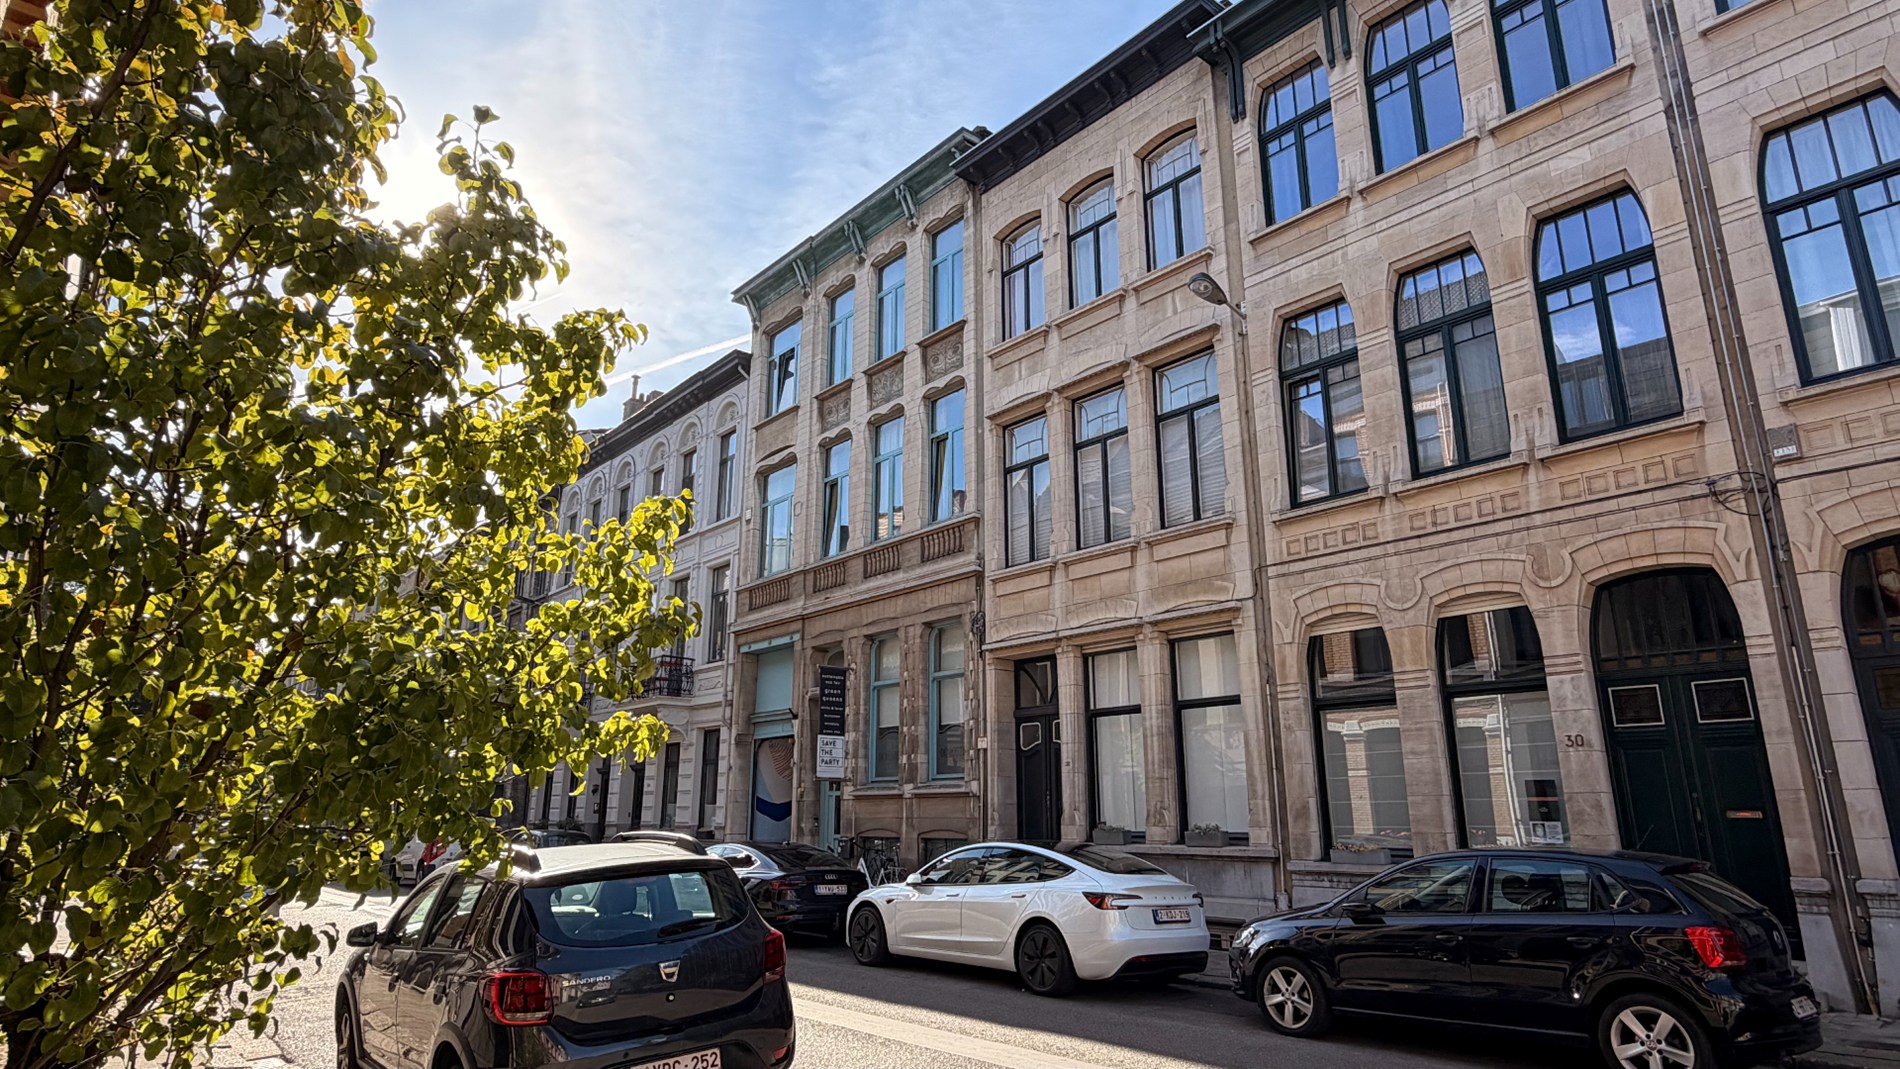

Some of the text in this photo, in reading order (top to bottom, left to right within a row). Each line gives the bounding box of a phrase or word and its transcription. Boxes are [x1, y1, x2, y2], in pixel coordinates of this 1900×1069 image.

[1564, 734, 1585, 748] 30
[821, 758, 840, 766] PARTY
[562, 975, 611, 988] SANDERO
